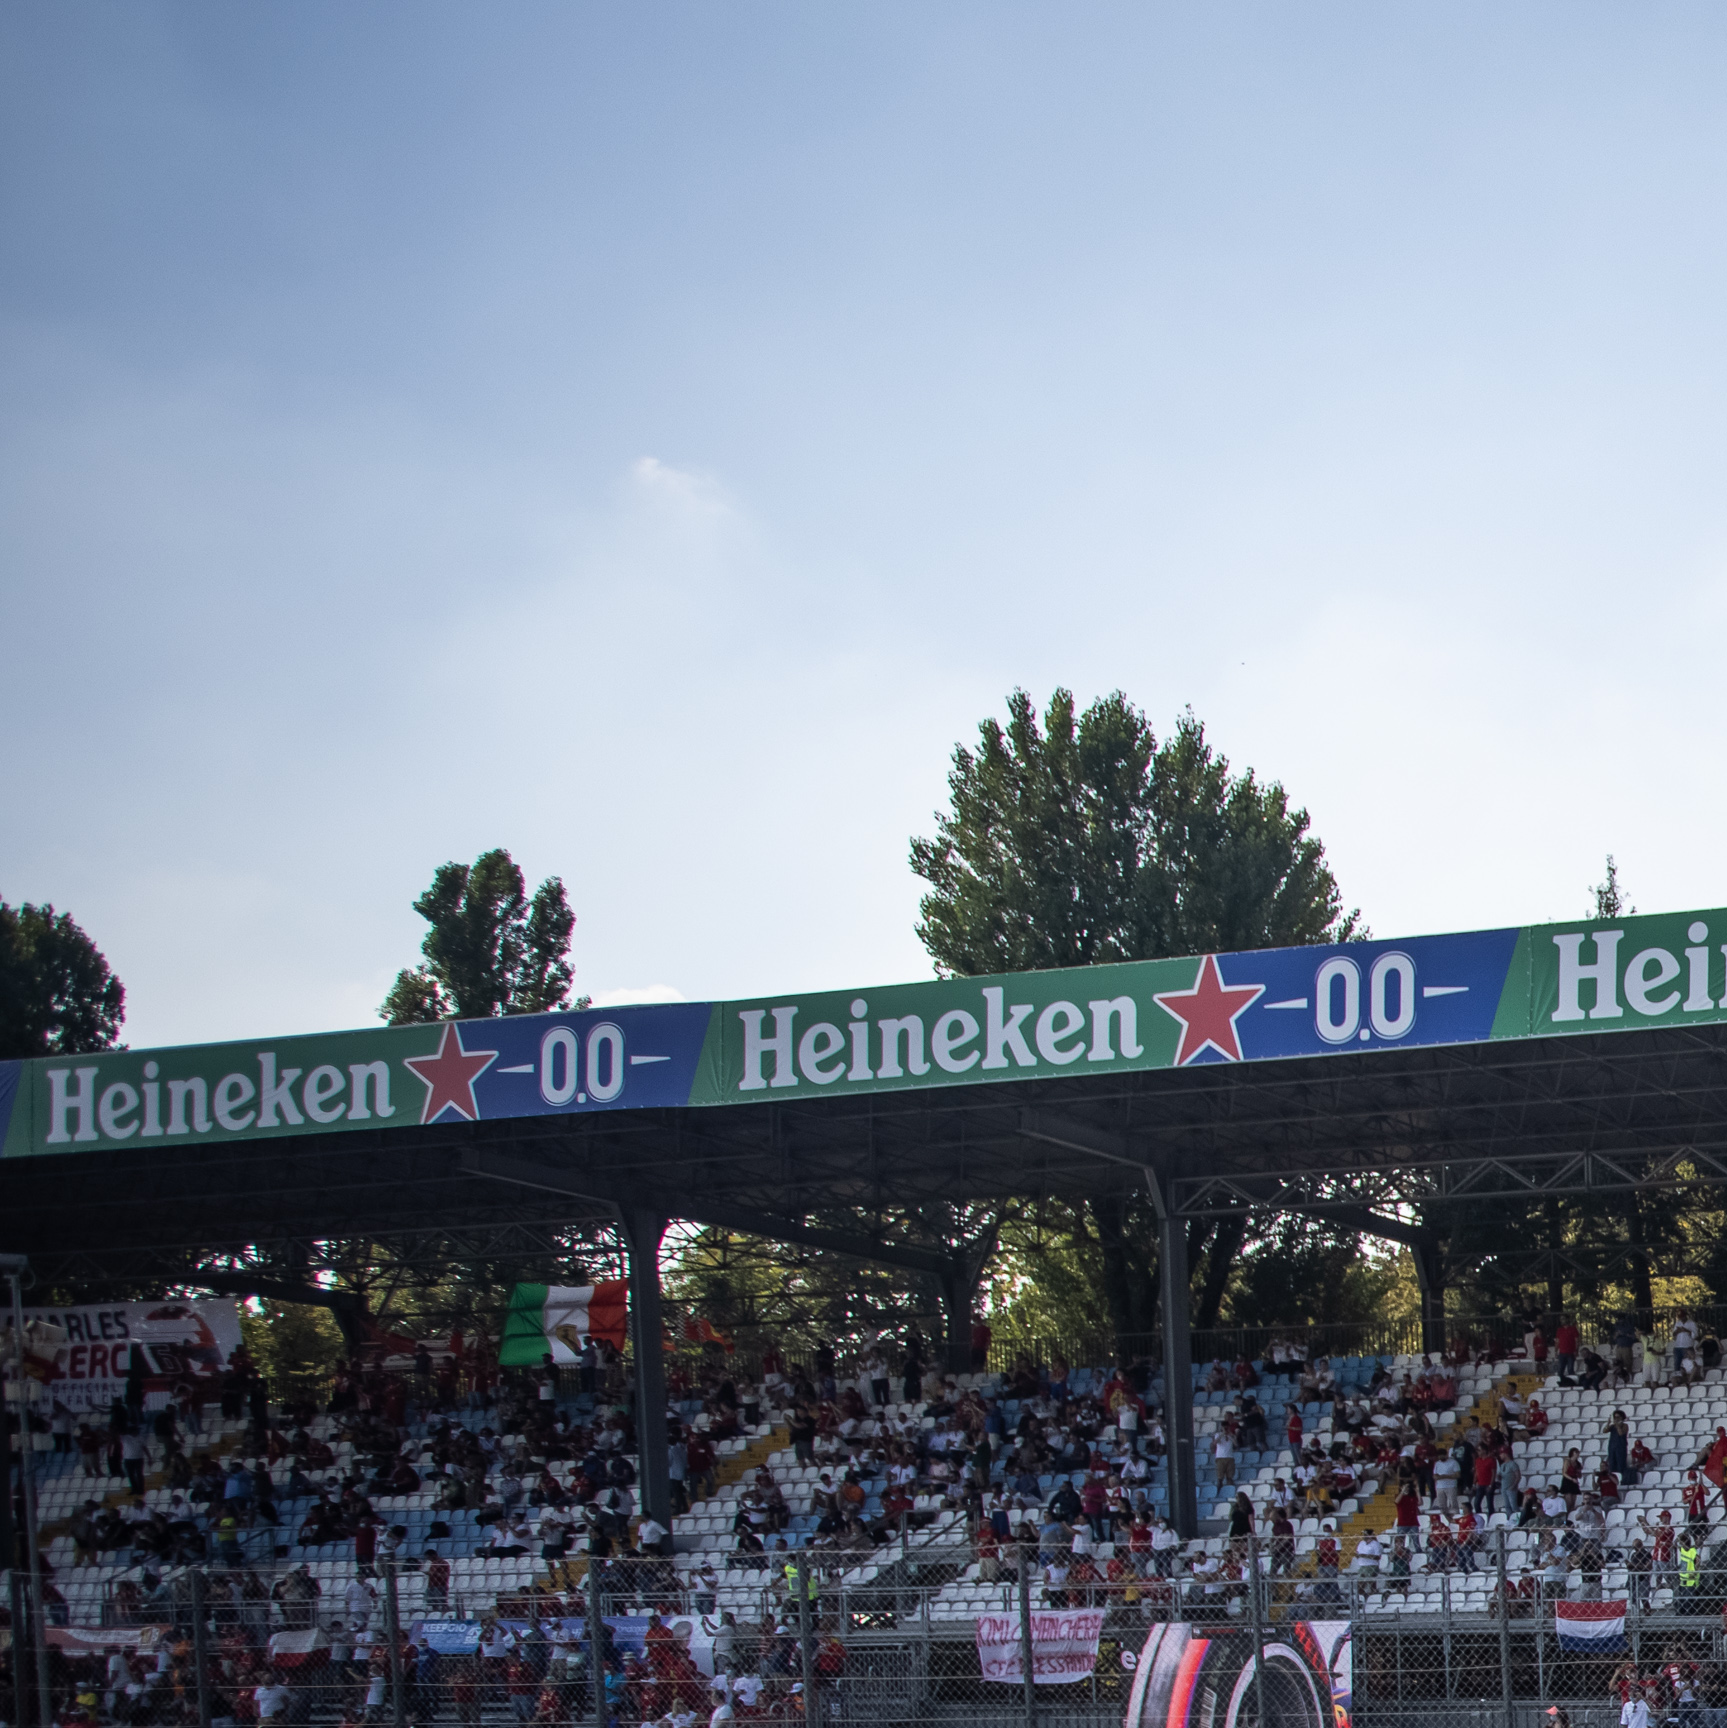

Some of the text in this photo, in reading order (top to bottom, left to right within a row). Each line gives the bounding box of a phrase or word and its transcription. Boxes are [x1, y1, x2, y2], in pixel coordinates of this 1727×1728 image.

[739, 986, 1143, 1090] Heineken
[1315, 950, 1416, 1046] 0.0
[47, 1053, 394, 1143] Heineken
[540, 1022, 624, 1106] 0.0
